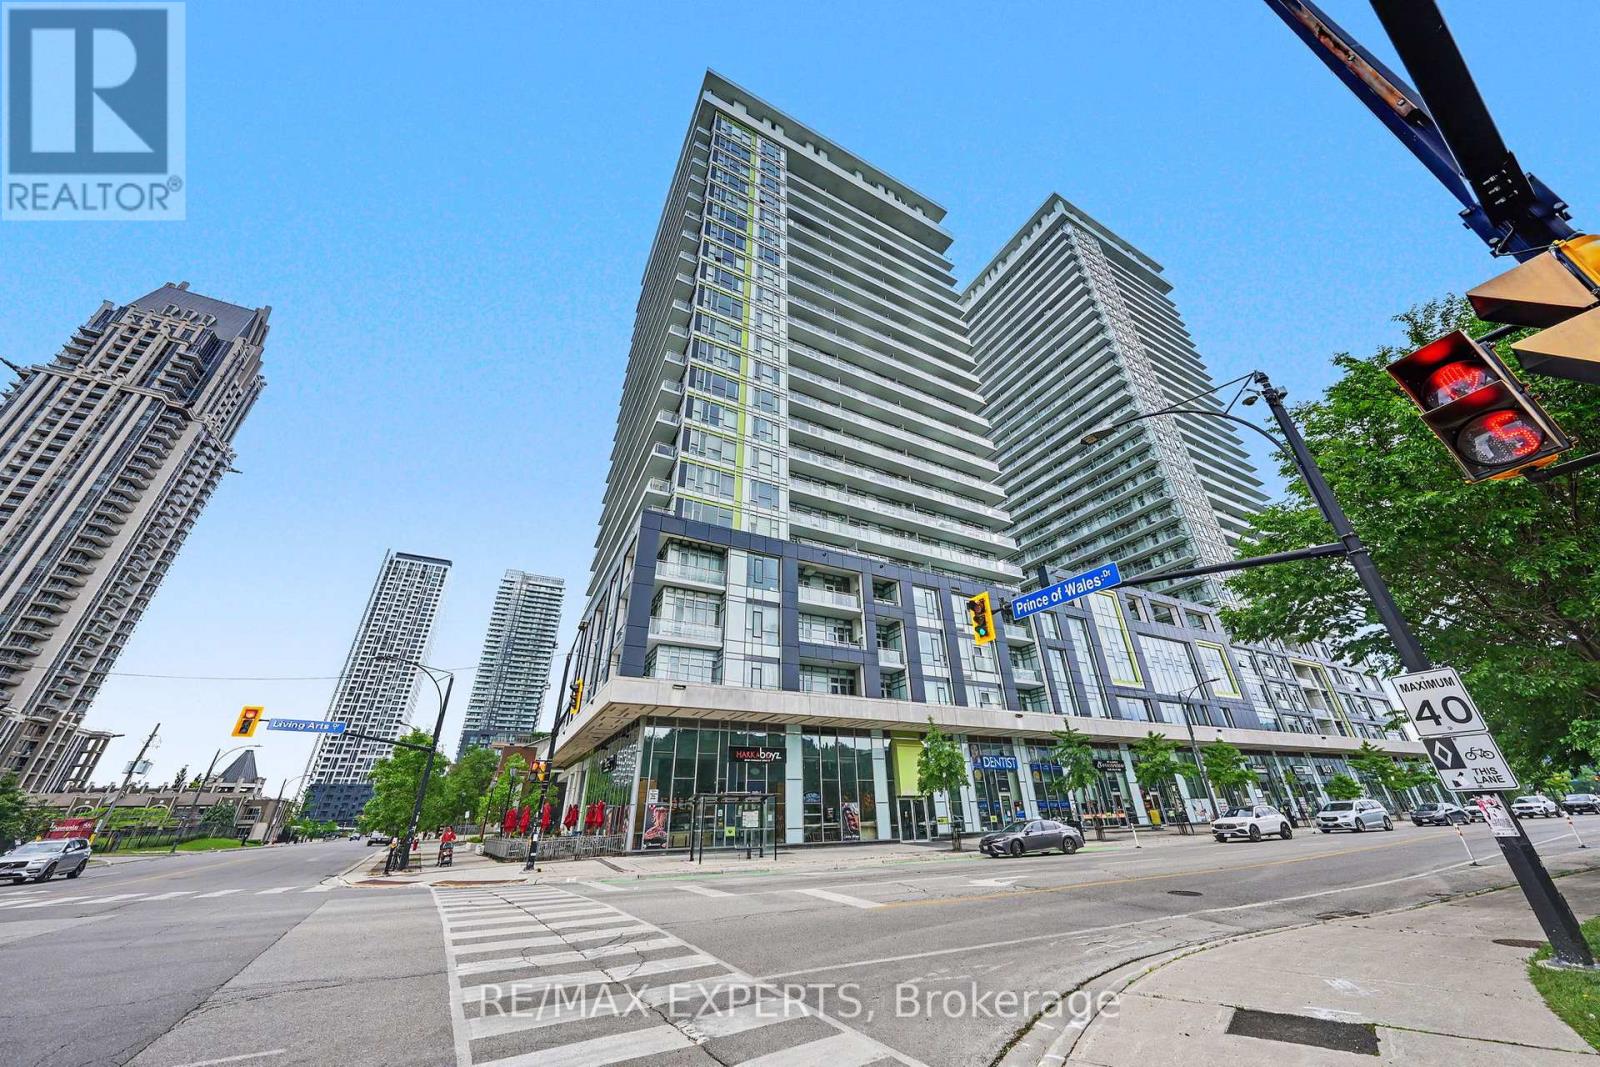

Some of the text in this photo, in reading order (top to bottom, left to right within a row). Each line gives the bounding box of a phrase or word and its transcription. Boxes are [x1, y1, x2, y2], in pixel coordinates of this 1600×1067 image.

[1016, 594, 1049, 615] Prince
[1051, 587, 1063, 602] of
[1065, 576, 1102, 597] Wales
[1399, 676, 1455, 693] MAXIMUM
[1415, 695, 1473, 726] 40
[273, 720, 305, 730] Living
[308, 722, 330, 730] Arts
[983, 757, 1016, 769] DENTIST
[1471, 767, 1498, 775] THIS
[1474, 775, 1505, 784] LANE
